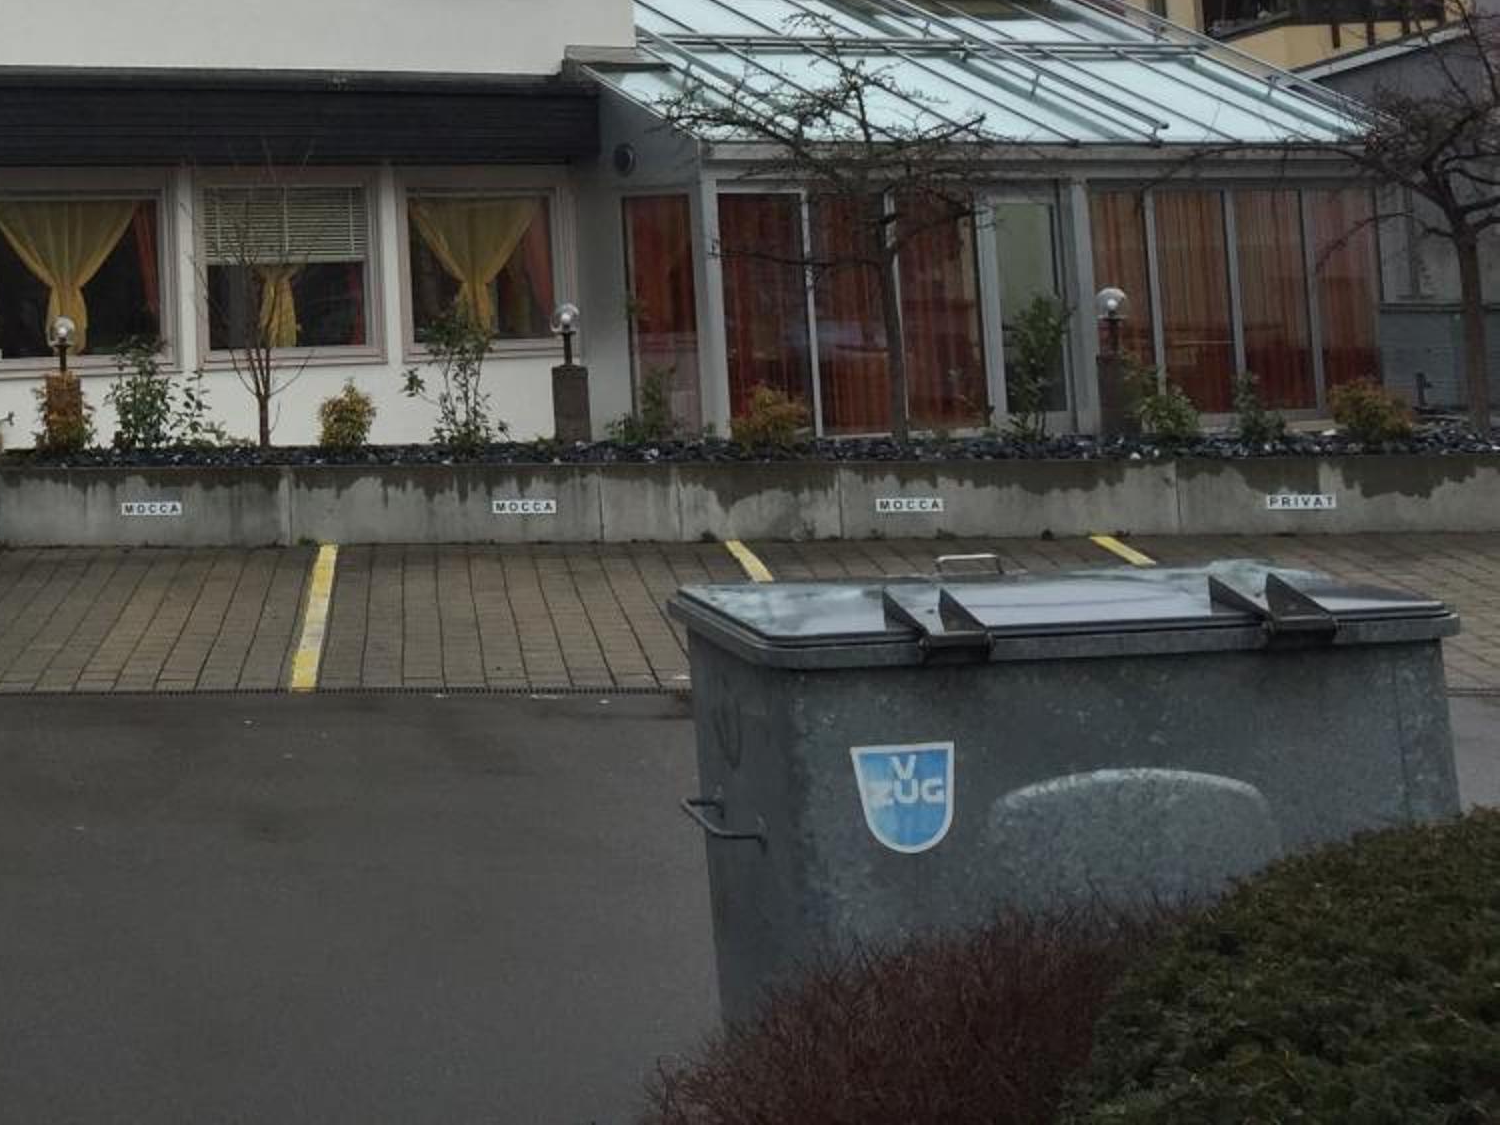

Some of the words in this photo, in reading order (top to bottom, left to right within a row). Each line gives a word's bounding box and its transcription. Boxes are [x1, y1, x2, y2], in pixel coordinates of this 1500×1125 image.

[495, 502, 553, 512] MOCCA
[879, 499, 940, 510] MOCCA
[1269, 496, 1333, 508] PRIVAT
[124, 503, 180, 514] MOCCA
[890, 754, 917, 779] V
[866, 777, 946, 807] ZUG
